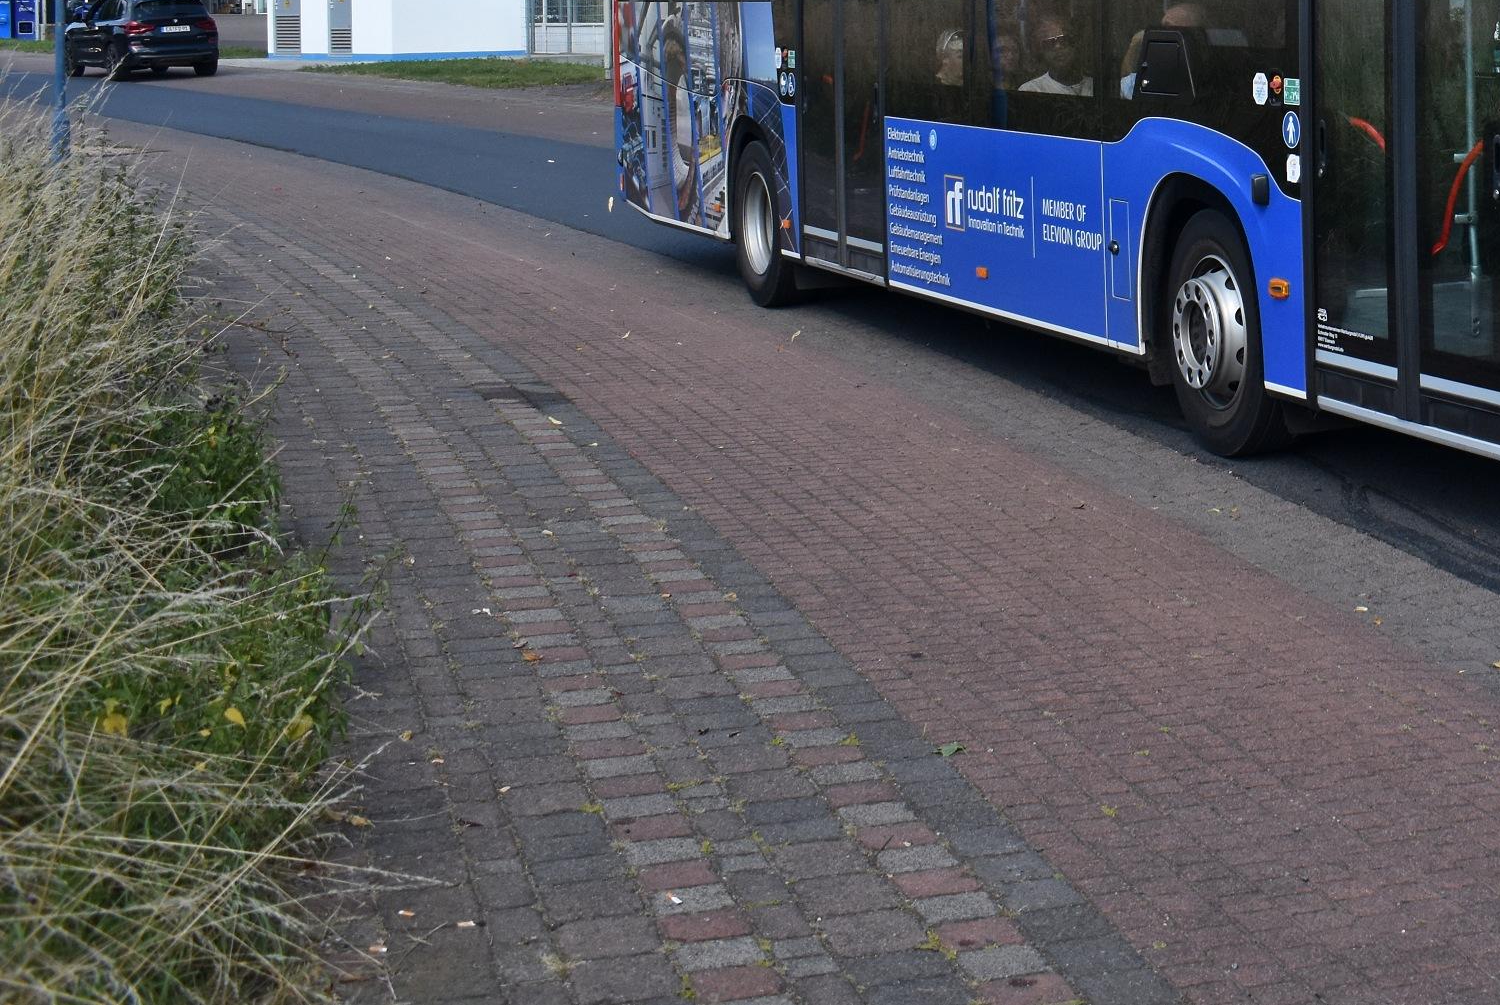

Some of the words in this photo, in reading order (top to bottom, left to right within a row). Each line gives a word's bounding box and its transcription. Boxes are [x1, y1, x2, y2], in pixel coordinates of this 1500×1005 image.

[888, 127, 920, 143] Elektrotechnik
[888, 146, 924, 163] Antriebstechnik
[889, 165, 926, 183] Luftfahrttechnik
[889, 184, 930, 205] Prüfstandanlagen
[967, 185, 1000, 214] rudolf
[1003, 189, 1025, 219] fritz
[890, 203, 937, 227] Gebäudeausrüstung
[1042, 198, 1074, 221] MEMBER
[1076, 204, 1087, 222] OF
[890, 222, 943, 245] Gebäudemanagement
[968, 215, 997, 232] Innovation
[997, 220, 1002, 233] in
[1003, 222, 1025, 238] Technik
[1043, 224, 1073, 245] ELEVION
[1075, 229, 1102, 251] GROUP
[891, 241, 918, 258] Erneuerbare
[920, 248, 941, 265] Energien
[891, 260, 951, 286] Automatisierungstechnik
